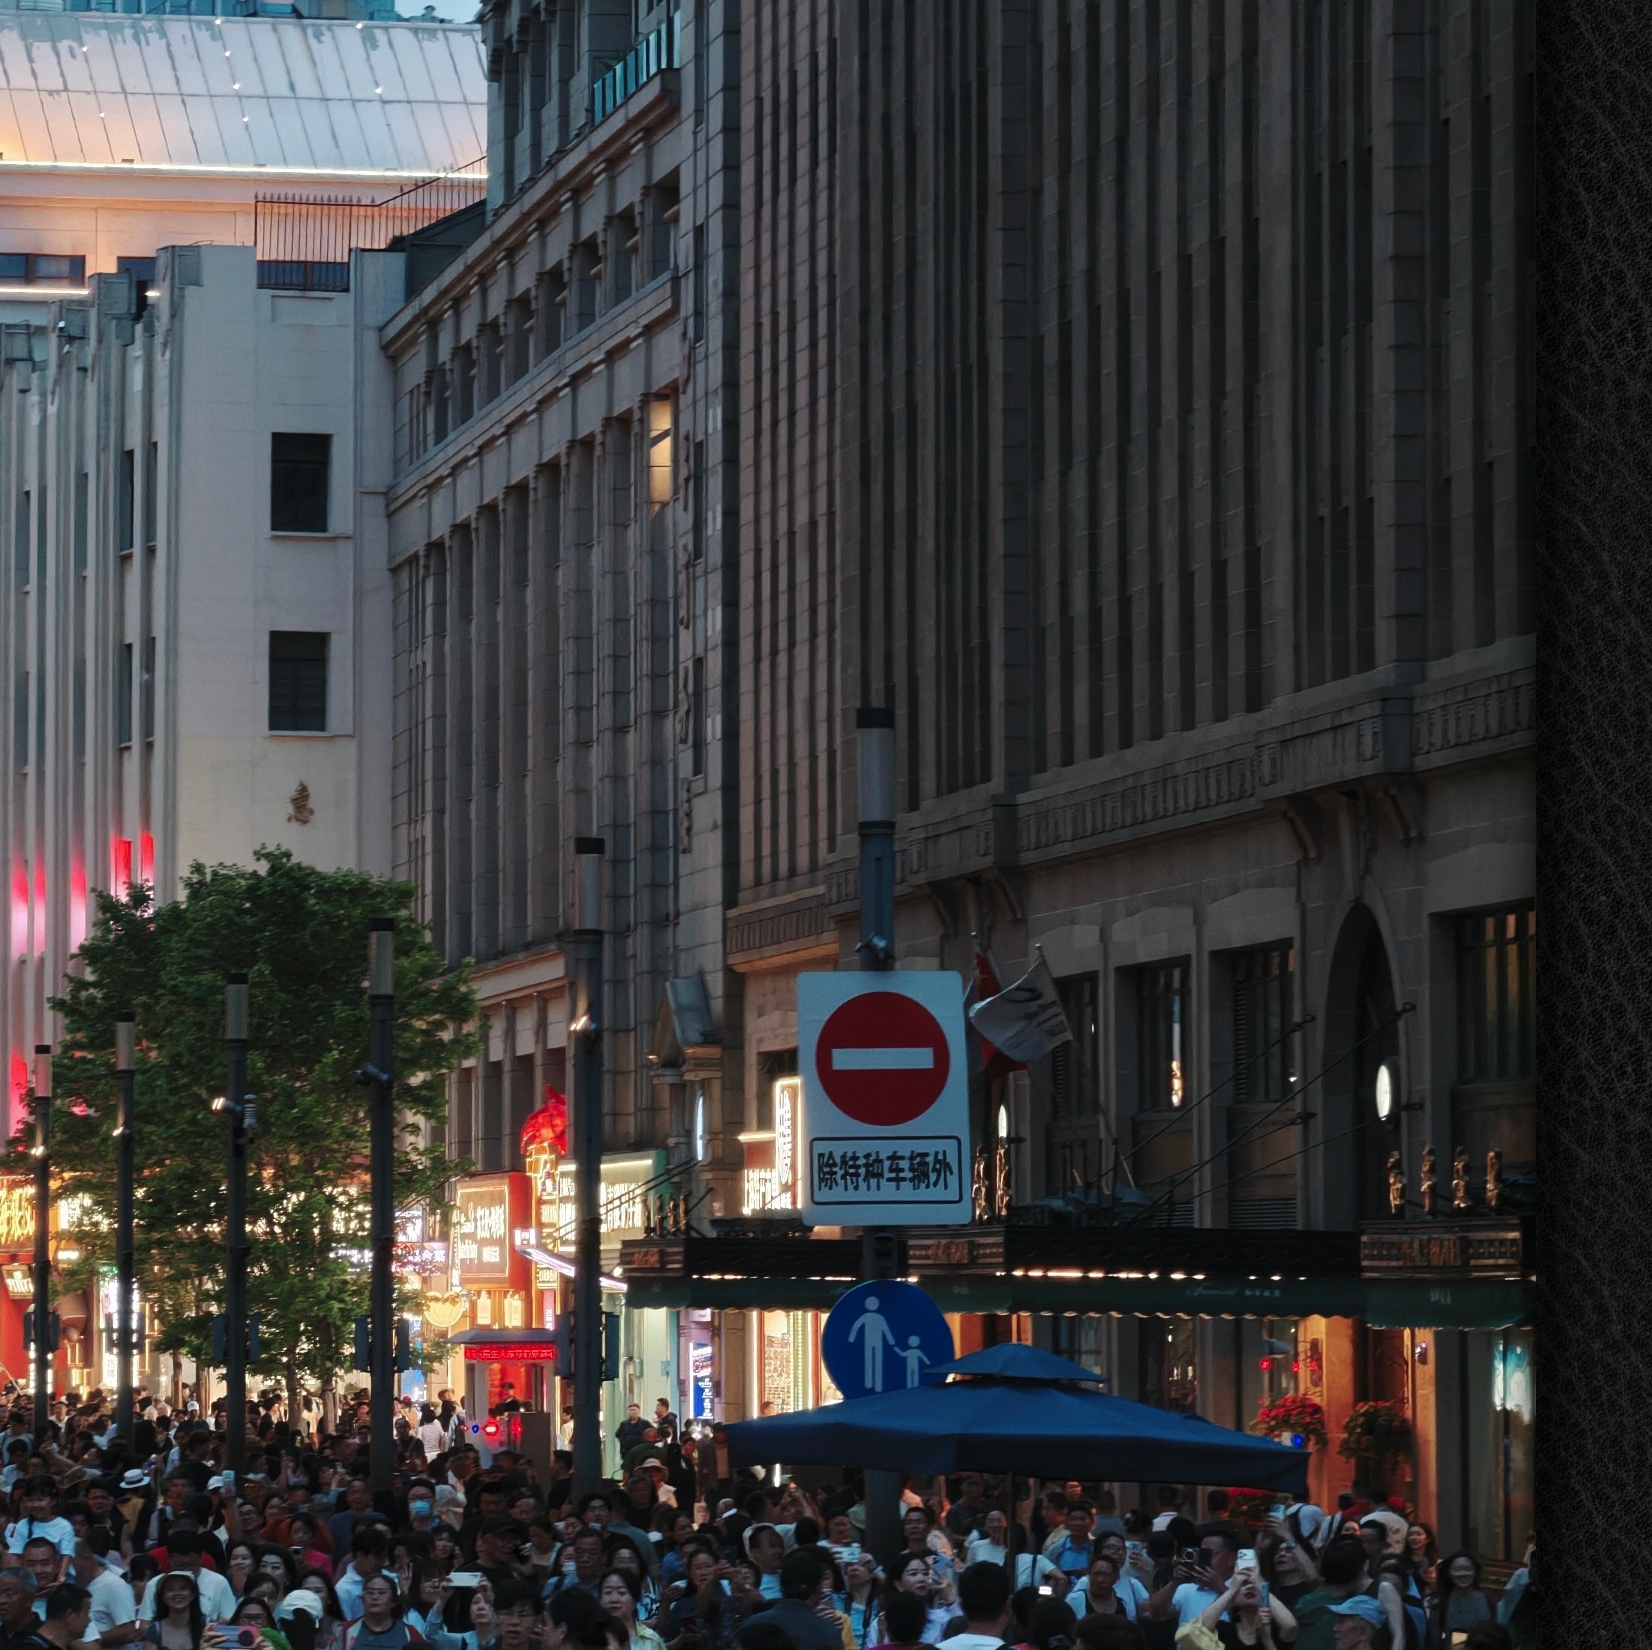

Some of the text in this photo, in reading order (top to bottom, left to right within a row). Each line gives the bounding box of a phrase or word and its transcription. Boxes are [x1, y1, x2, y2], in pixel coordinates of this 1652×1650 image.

[817, 1149, 954, 1192] 除特种车辆外
